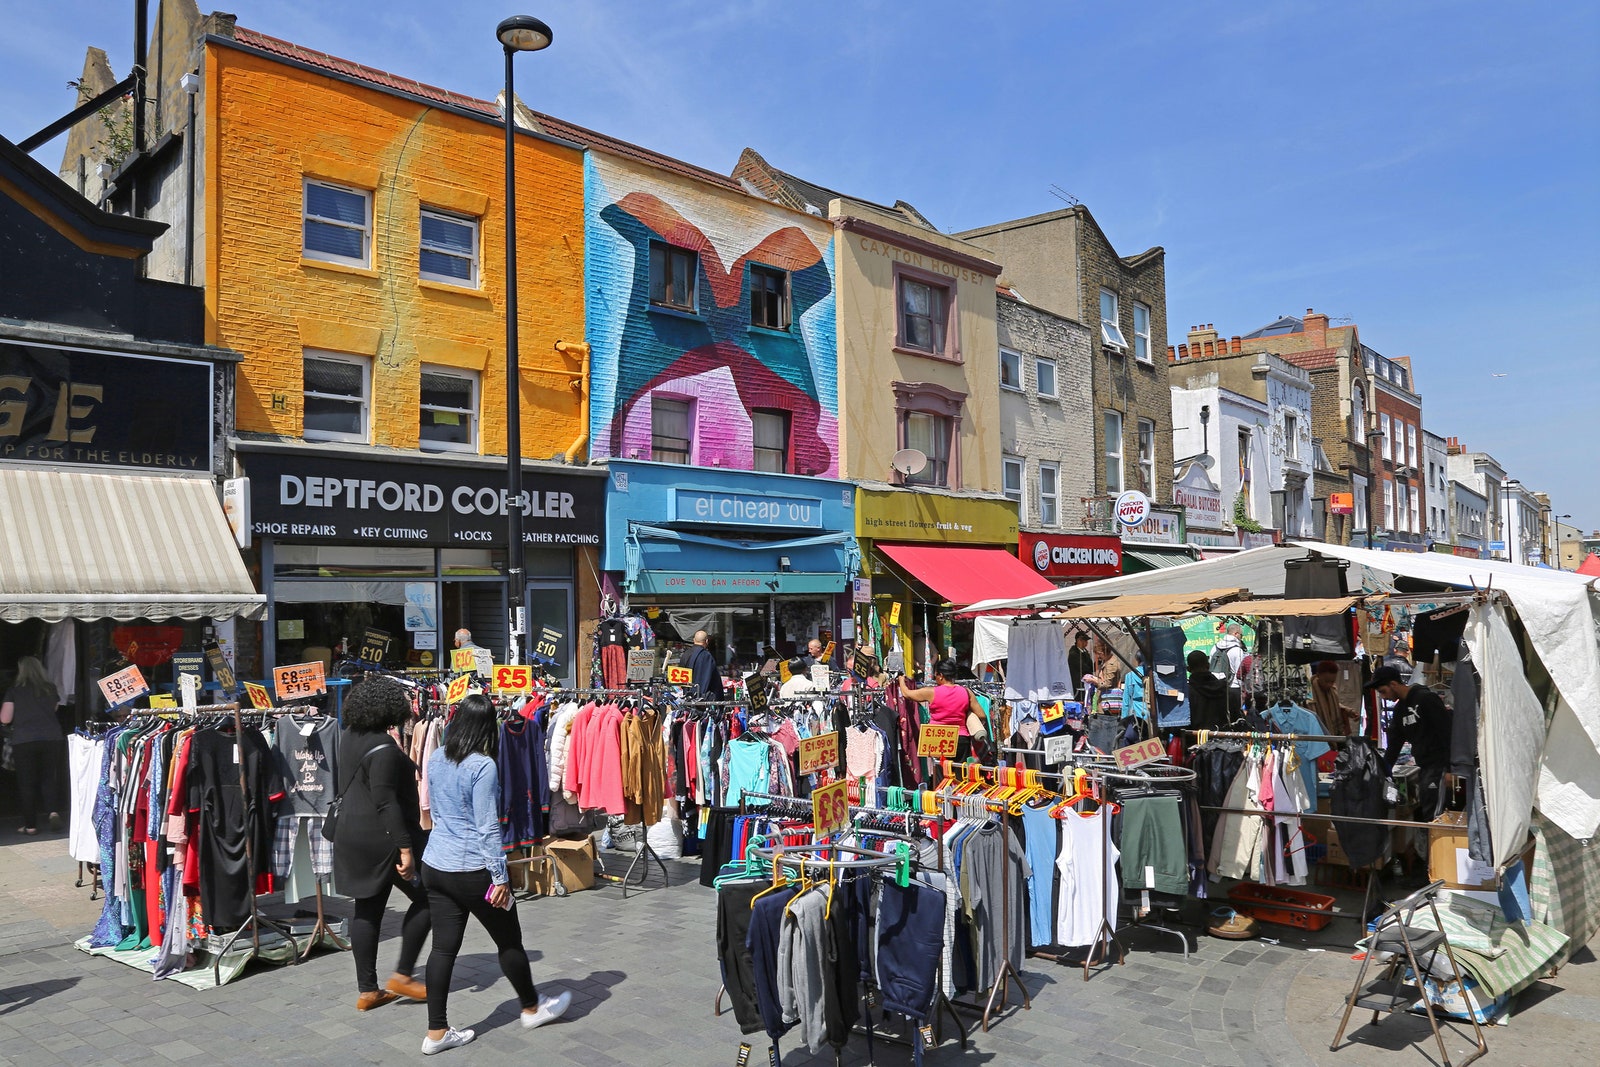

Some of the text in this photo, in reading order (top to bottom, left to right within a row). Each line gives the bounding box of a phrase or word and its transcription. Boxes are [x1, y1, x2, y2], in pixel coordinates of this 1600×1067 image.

[859, 237, 924, 268] CAXTON
[26, 445, 65, 460] FOR
[75, 449, 111, 463] THE
[118, 451, 198, 467] ELDERLY
[280, 474, 444, 513] DEPTFORD
[695, 494, 714, 517] el
[720, 496, 780, 523] cheap
[1119, 506, 1144, 516] KING
[255, 522, 599, 544] SHOE REPAIRS KEY CUTTING LOCKS EATHER PATCHING
[865, 517, 883, 527] high
[885, 518, 907, 528] street
[908, 519, 935, 529] flowers
[936, 521, 952, 530] fruit
[961, 524, 973, 533] veg
[1052, 547, 1115, 565] CHICKEN KING
[665, 577, 761, 587] LOVE YOU CAN AFFORD
[1181, 614, 1206, 631] elcome
[360, 646, 383, 662] £10
[536, 641, 556, 657] £10
[455, 650, 472, 668] £10
[217, 667, 235, 688] £8
[281, 671, 298, 685] £8
[497, 667, 528, 689] £5
[670, 668, 690, 683] £5
[854, 662, 867, 678] £5
[106, 678, 122, 693] £8
[115, 684, 135, 699] £15
[286, 682, 311, 694] £15
[449, 678, 467, 700] £5
[249, 686, 270, 709] £8
[752, 692, 767, 709] £5
[1044, 702, 1062, 719] £1
[925, 728, 946, 738] £1.99
[804, 738, 834, 752] £1.99 or
[922, 739, 955, 753] 3 for £5
[294, 749, 325, 764] Wake Up
[803, 749, 837, 770] 3 for £5
[1119, 741, 1162, 767] £10
[300, 760, 318, 773] And
[303, 772, 315, 784] Be
[291, 780, 324, 793] Awesome
[818, 788, 846, 830] £6
